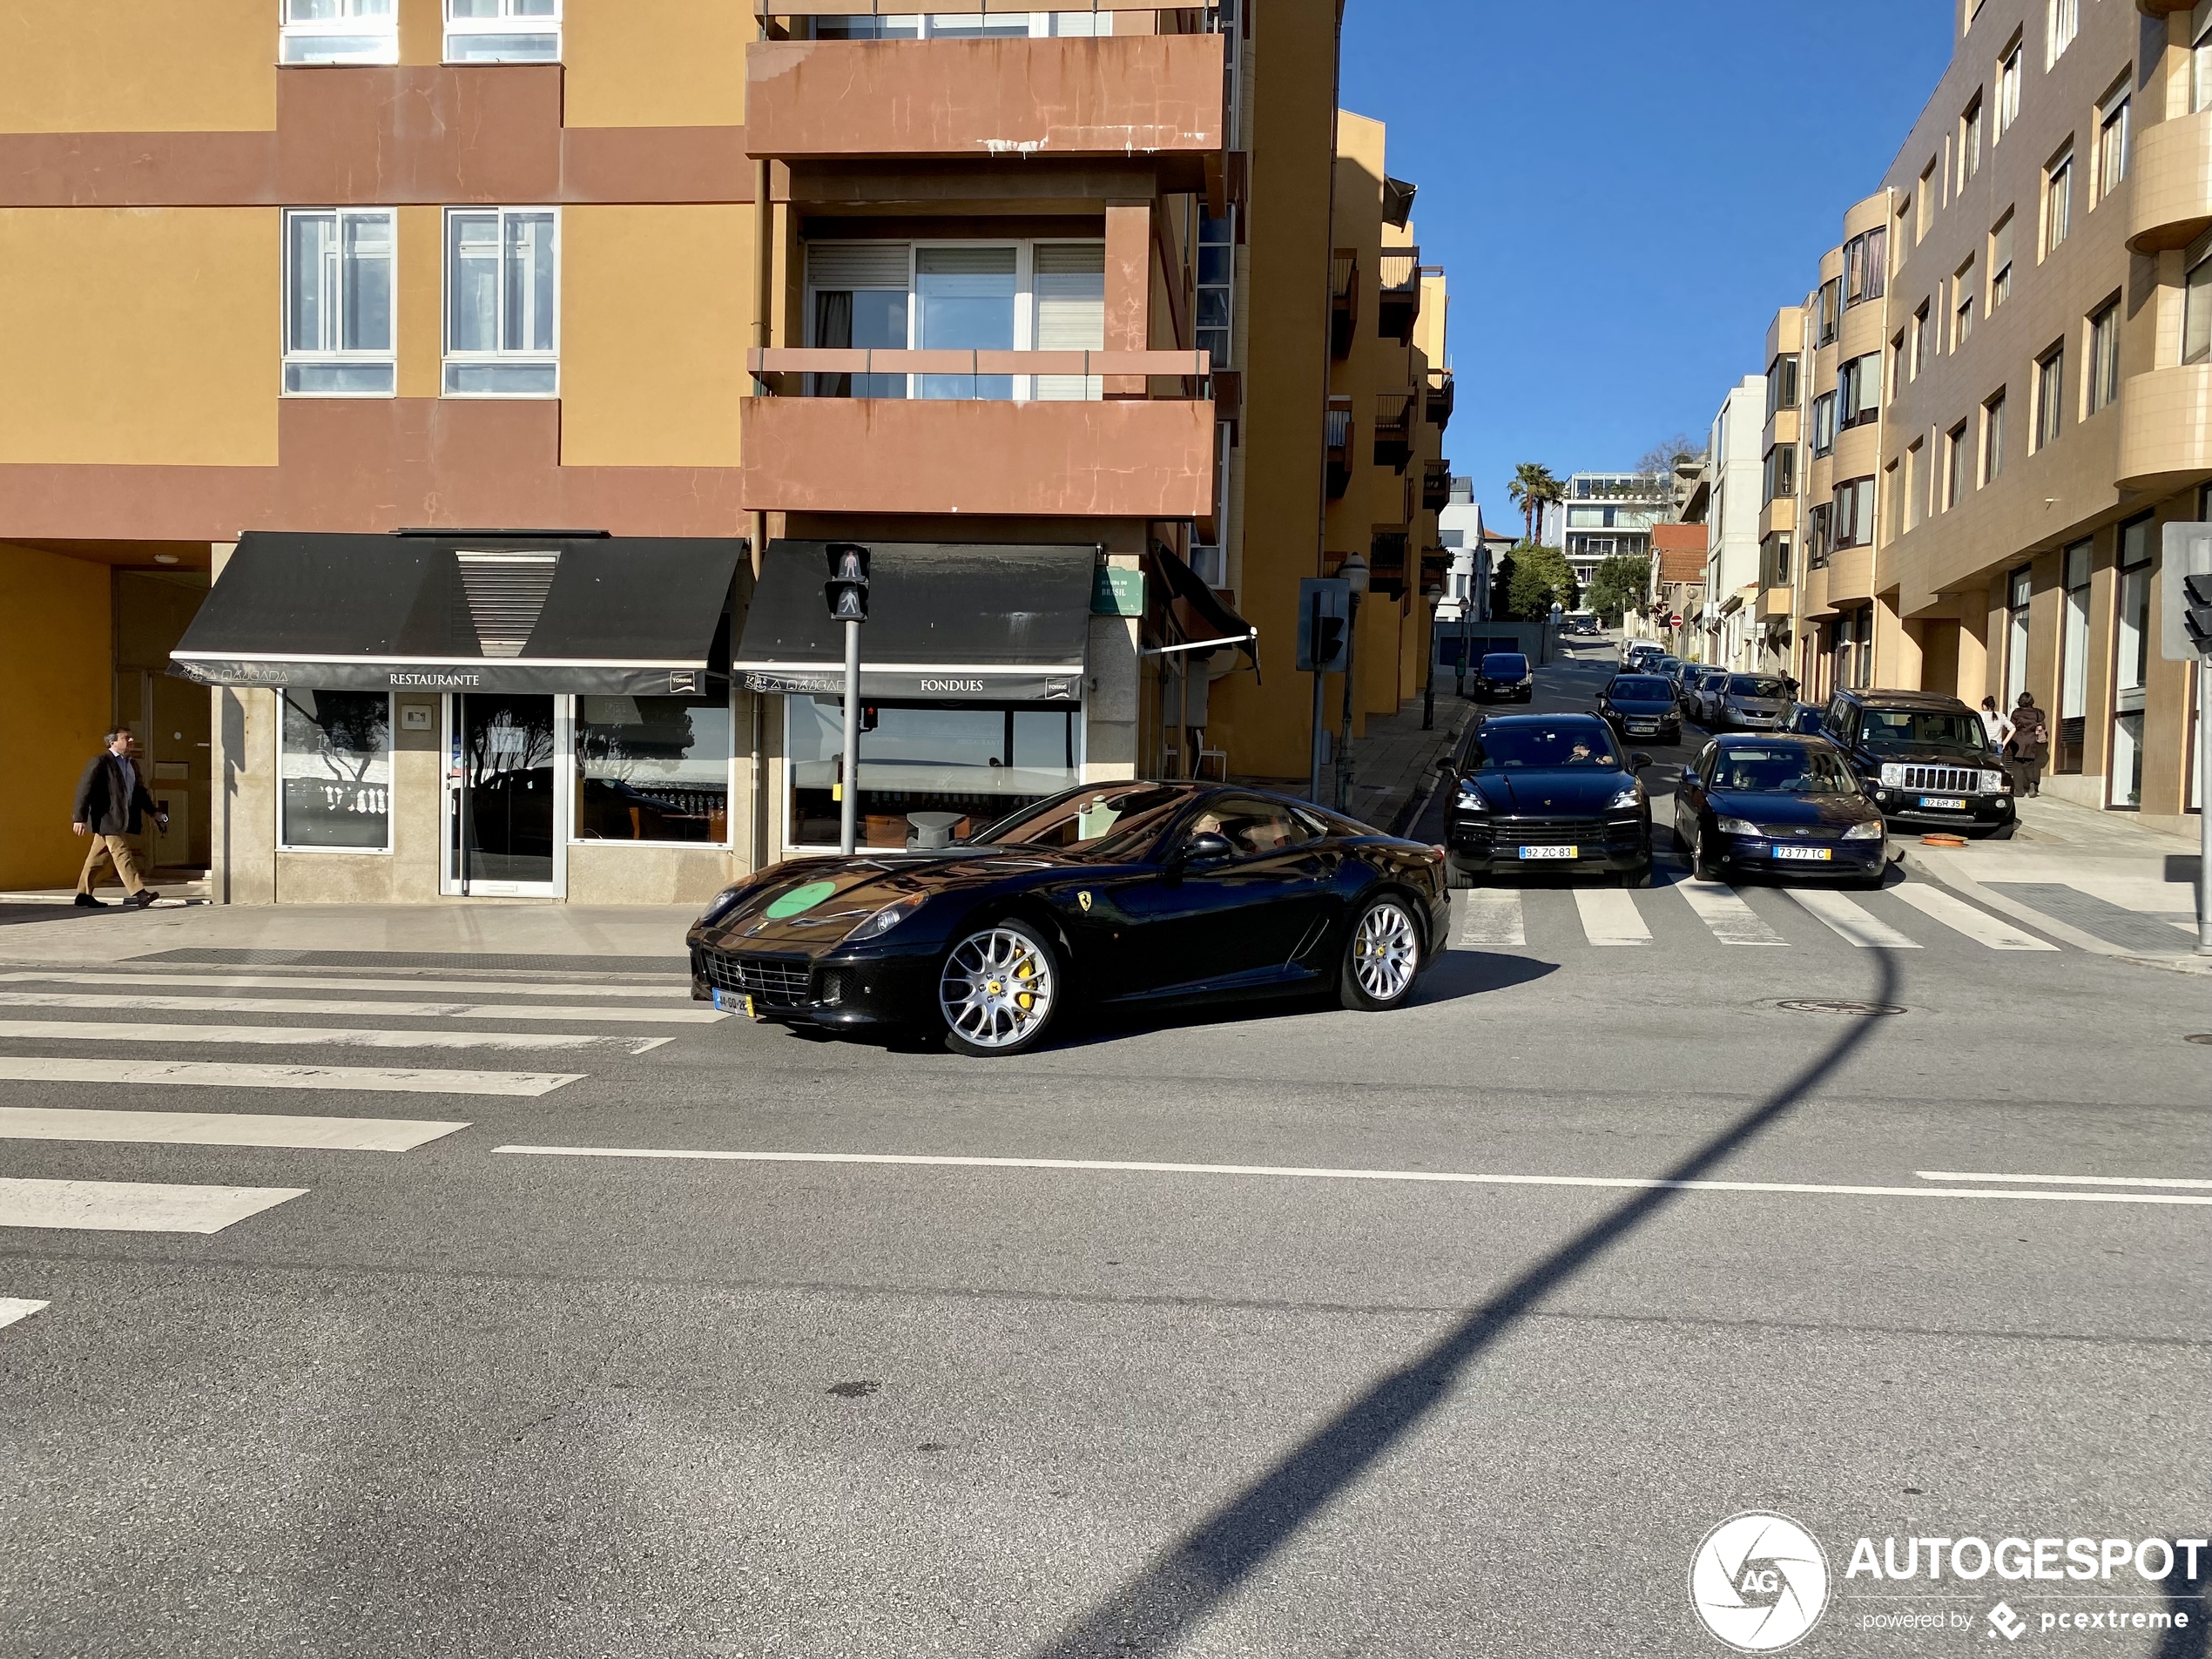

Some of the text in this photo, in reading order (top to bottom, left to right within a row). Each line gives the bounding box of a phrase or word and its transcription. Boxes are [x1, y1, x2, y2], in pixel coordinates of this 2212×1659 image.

[1101, 588, 1126, 597] BRASIL
[389, 673, 479, 686] RESTAURANTE
[921, 679, 983, 691] FONDUES
